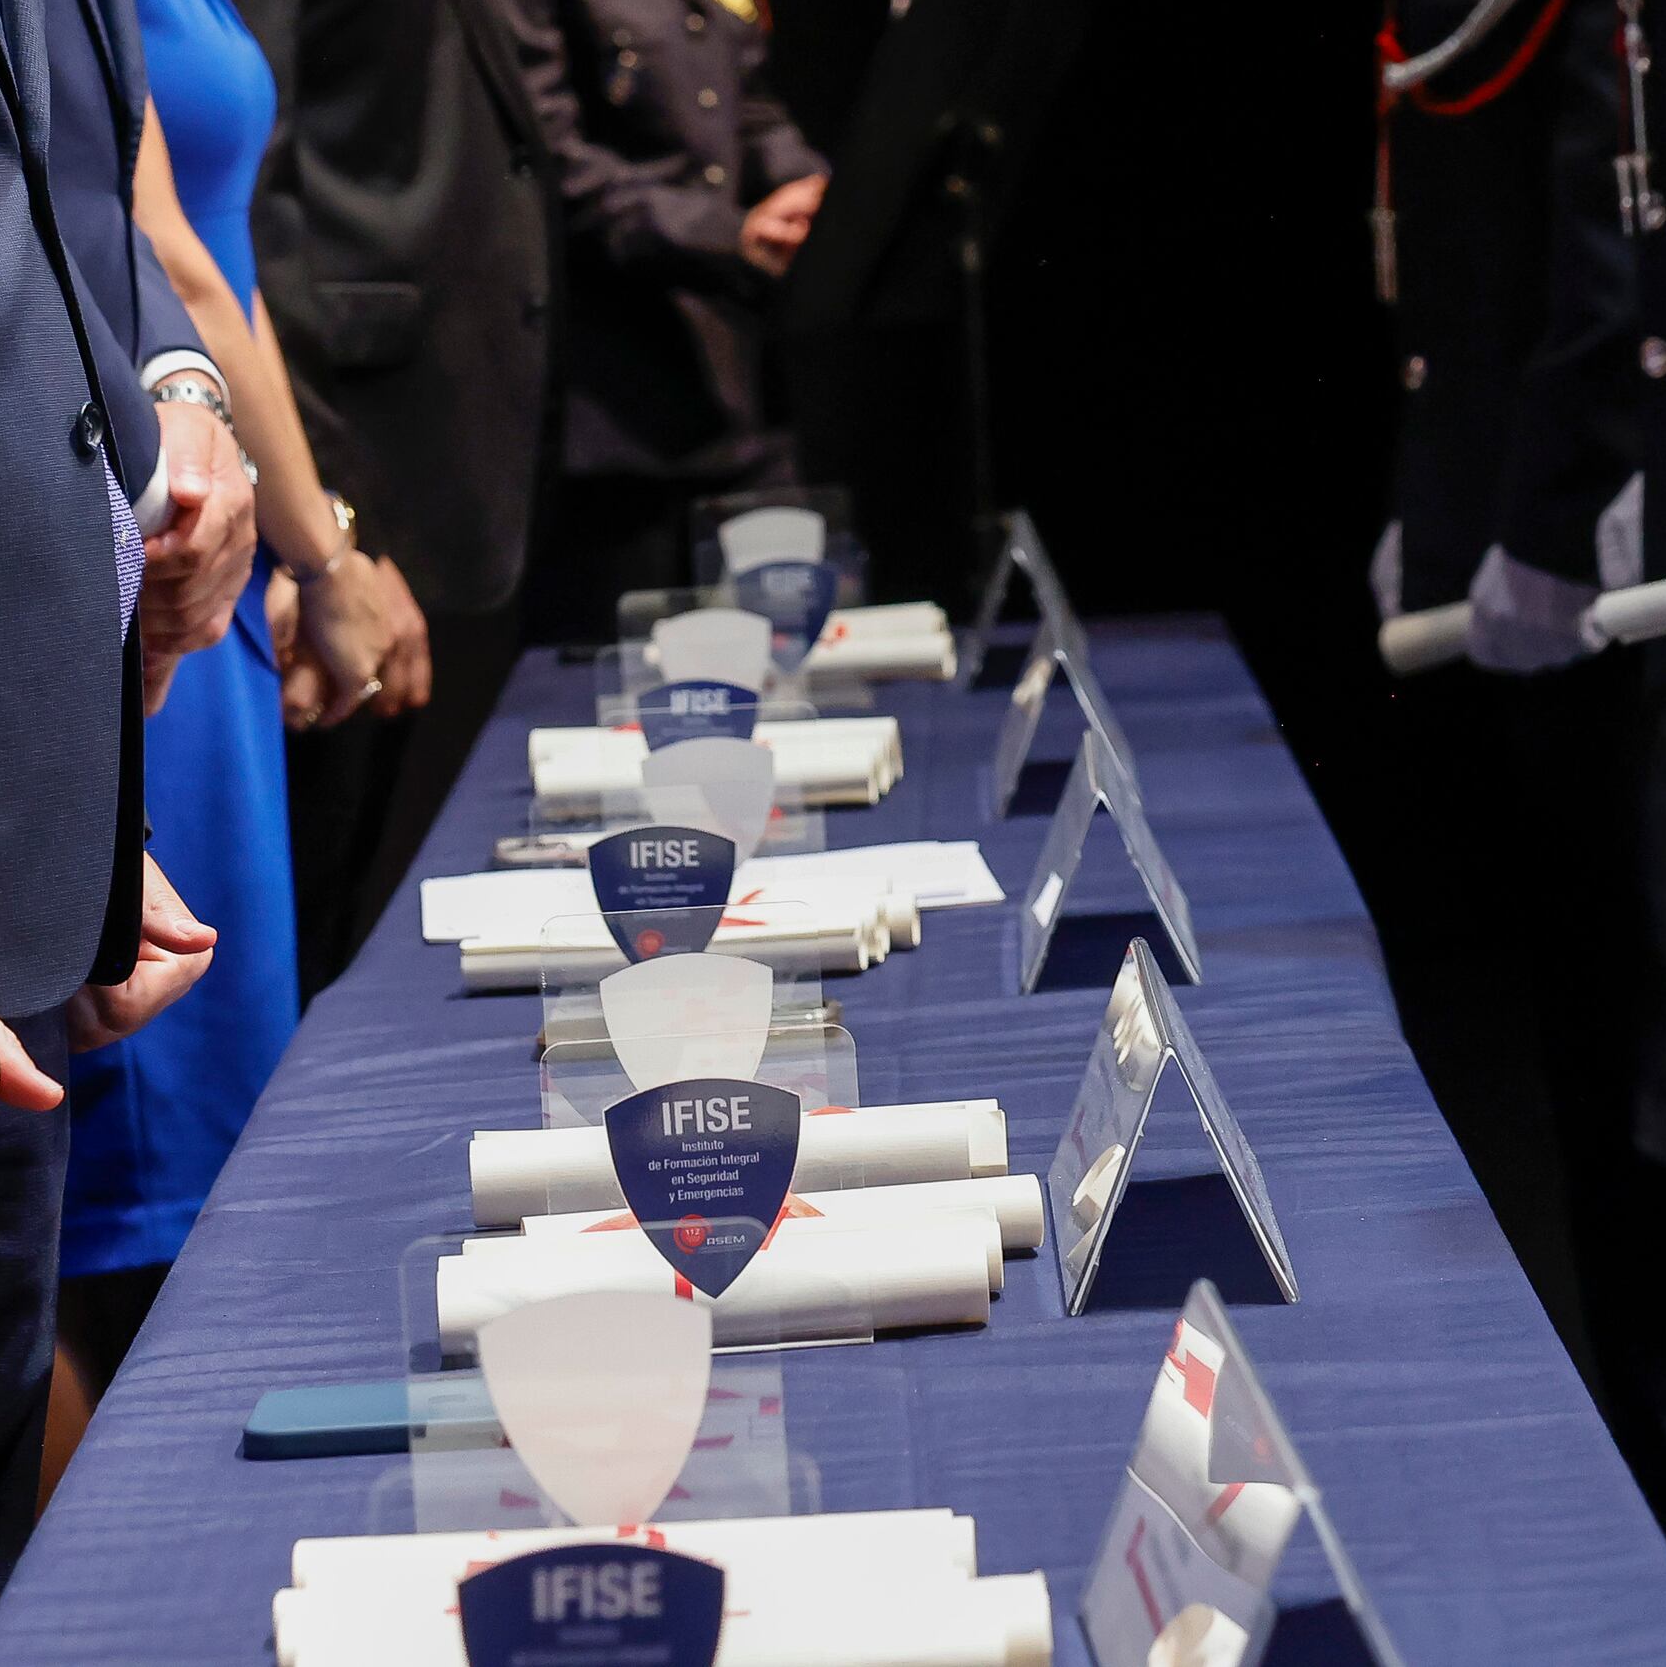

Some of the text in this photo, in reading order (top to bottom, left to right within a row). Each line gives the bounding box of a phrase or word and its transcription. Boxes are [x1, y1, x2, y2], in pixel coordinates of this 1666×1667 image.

[629, 839, 701, 869] IFISE
[661, 1096, 752, 1136] IFISE
[681, 1140, 724, 1152] Instituto
[648, 1152, 759, 1171] de Formación Integral
[671, 1170, 739, 1185] en Seguridad
[668, 1186, 744, 1203] y Emergencias
[532, 1561, 663, 1622] IFISE
